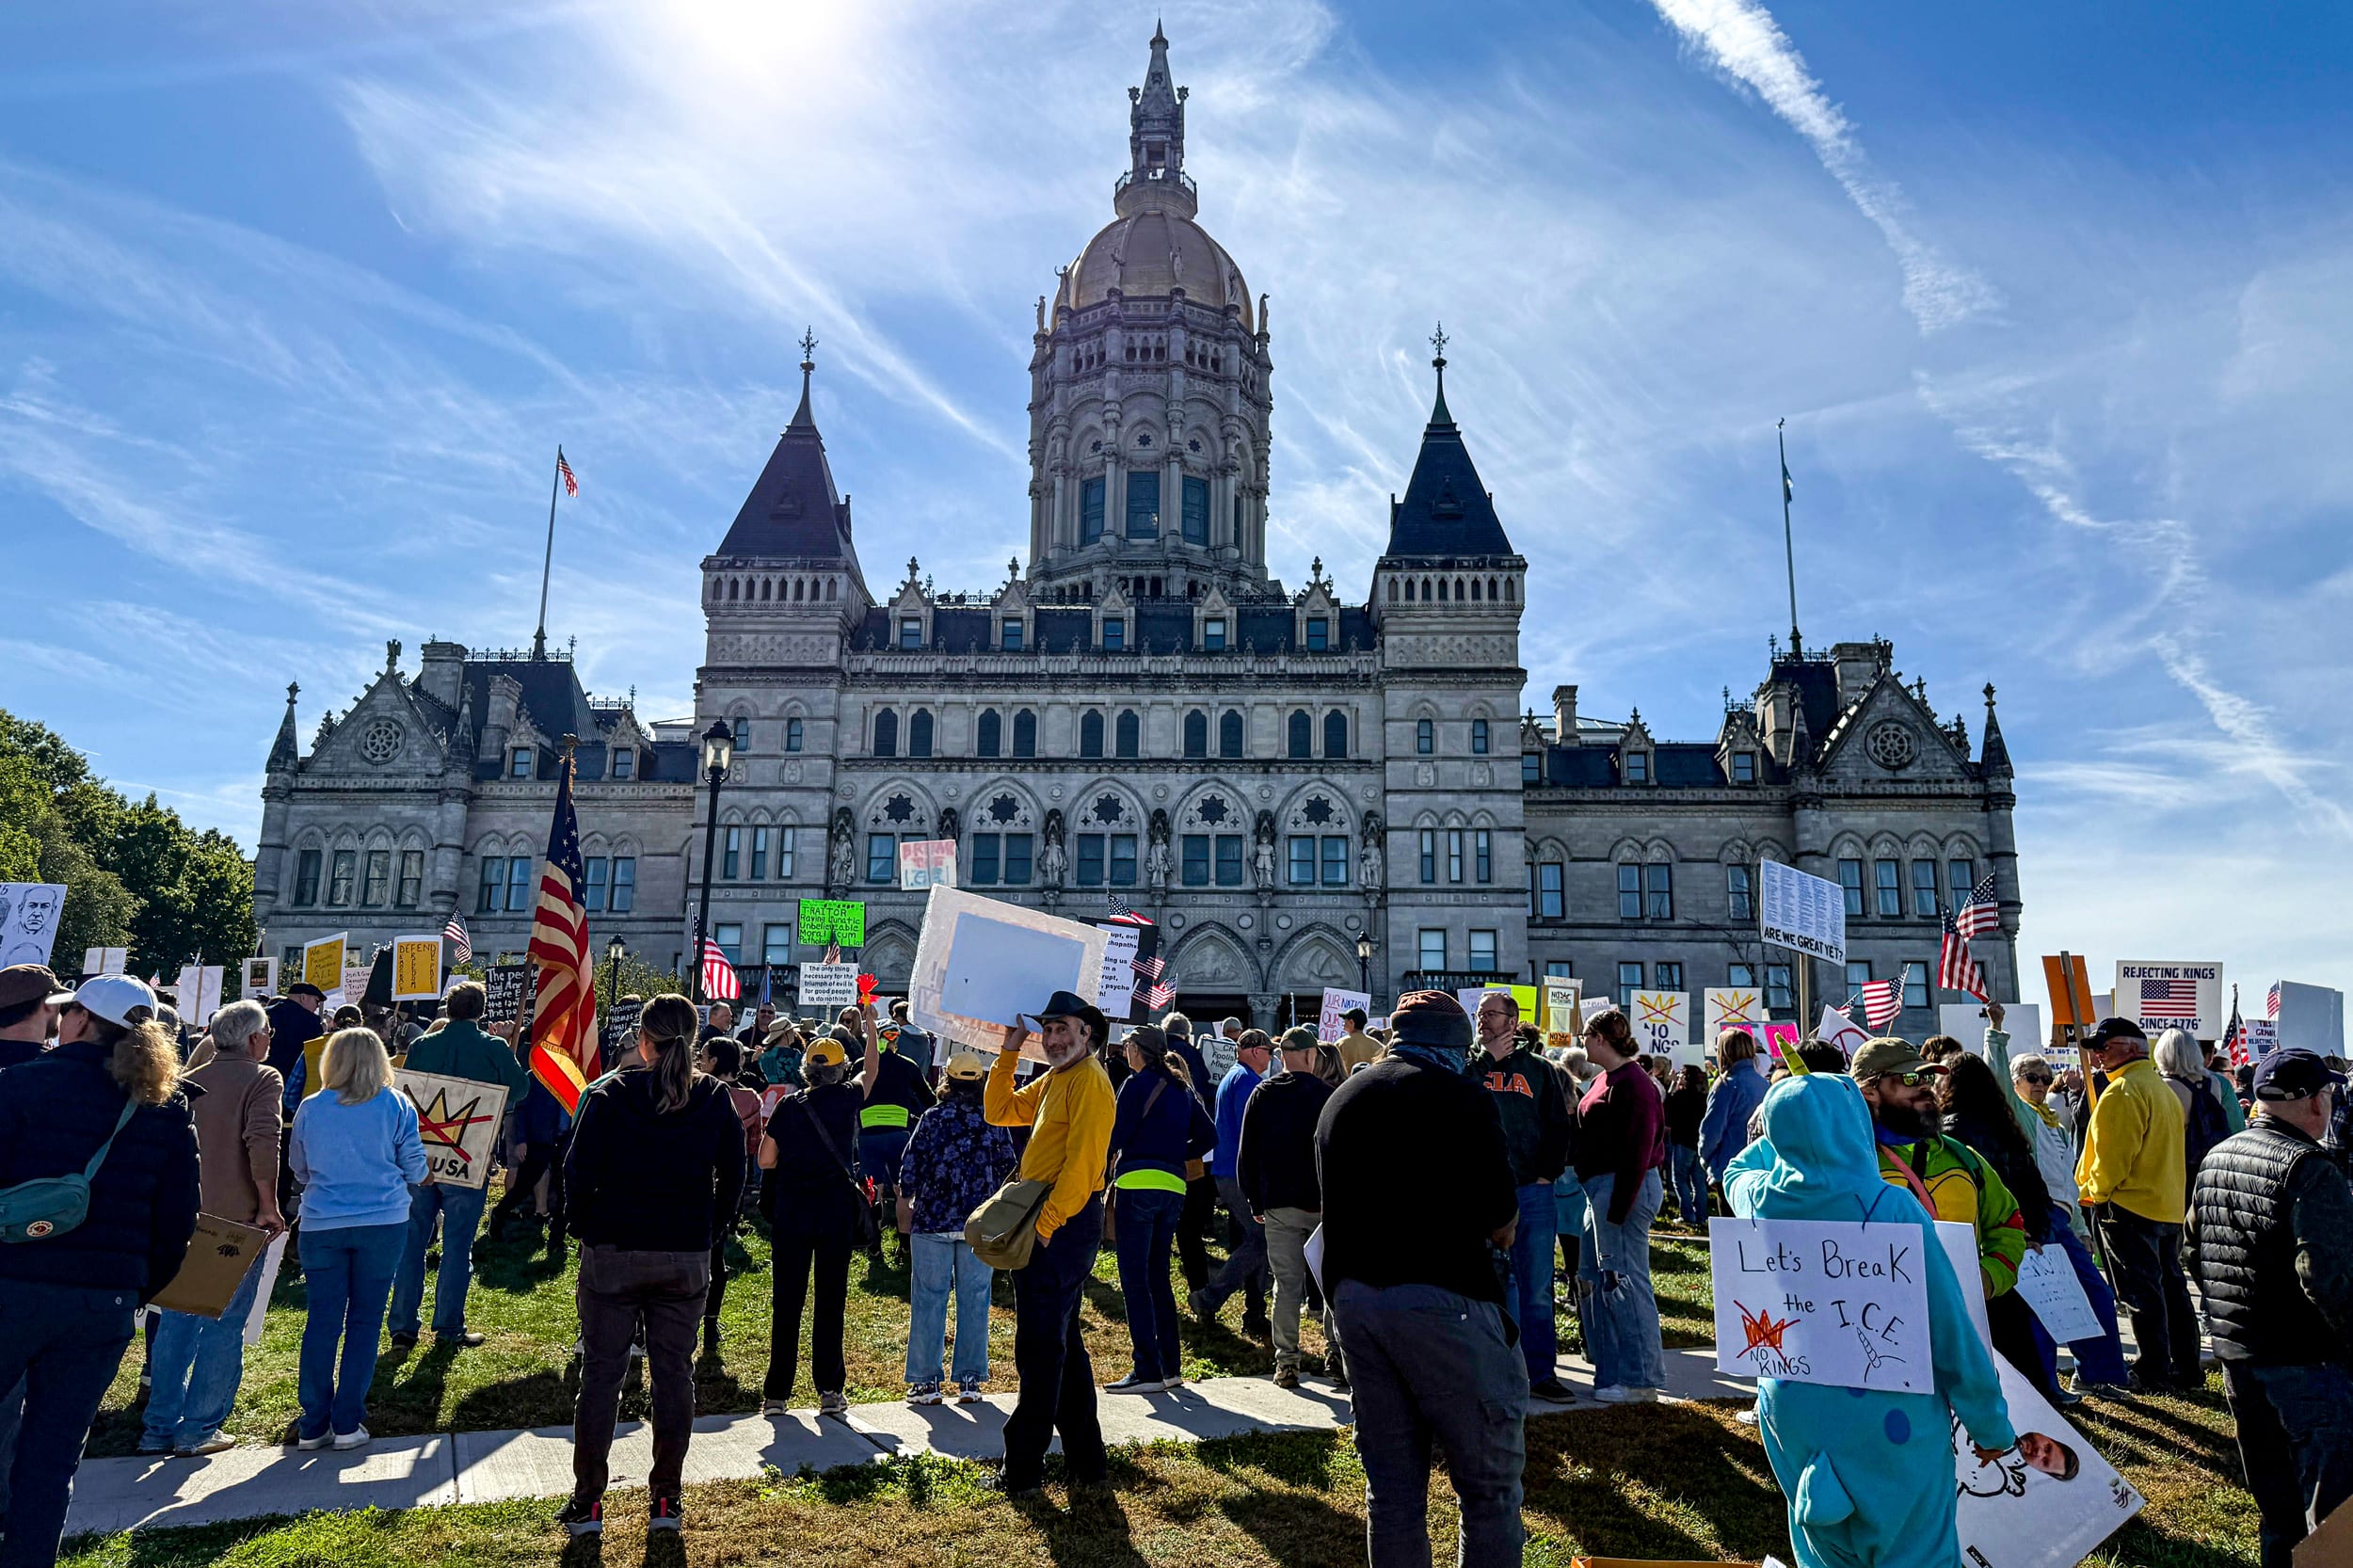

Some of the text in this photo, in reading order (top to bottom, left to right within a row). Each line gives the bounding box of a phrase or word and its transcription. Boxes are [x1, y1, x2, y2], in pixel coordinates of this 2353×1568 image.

[802, 906, 846, 917] TRAITOR
[801, 914, 825, 922] Raving
[800, 929, 826, 937] Moral
[399, 943, 437, 953] DEFEND
[1764, 926, 1843, 961] ARE WE GREAT YET?
[486, 968, 504, 983] The
[2122, 966, 2215, 980] REJECTING KINGS
[488, 982, 504, 991] hid
[488, 991, 513, 1000] were
[488, 1000, 503, 1008] the
[1323, 993, 1368, 1011] OUR NATION
[488, 1008, 504, 1018] The
[2138, 1017, 2169, 1030] SINCE
[1549, 1032, 1559, 1041] NO
[1212, 1050, 1236, 1062] Foolis
[433, 1157, 469, 1179] USA
[1738, 1240, 1801, 1272] Let's
[1783, 1293, 1816, 1313] the
[1750, 1347, 1769, 1362] NO
[1759, 1356, 1811, 1376] KINGS
